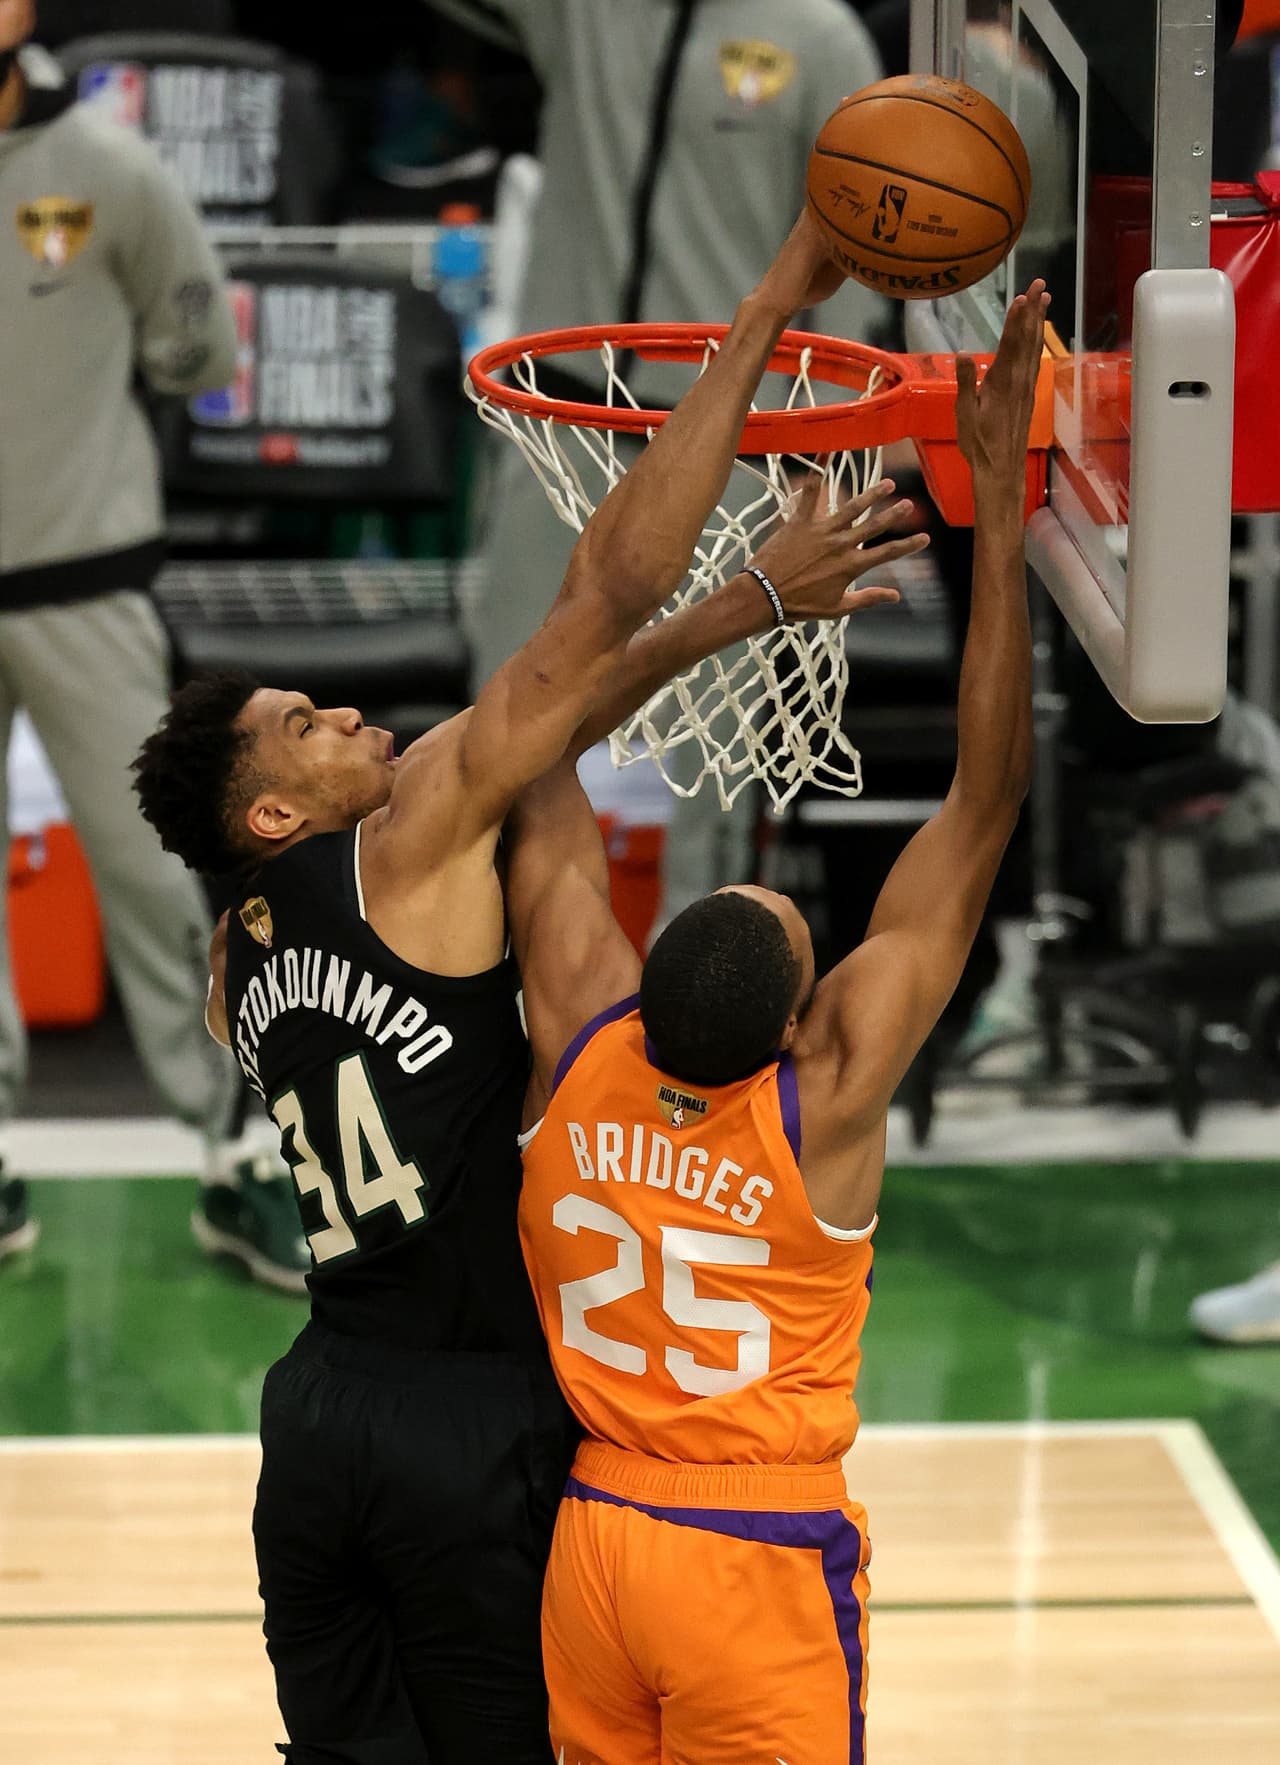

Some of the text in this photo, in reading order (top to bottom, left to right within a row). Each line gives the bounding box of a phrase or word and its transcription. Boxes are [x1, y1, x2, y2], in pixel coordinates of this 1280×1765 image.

[833, 246, 960, 291] SPALDIN
[237, 948, 453, 1101] TETOKOUNMPO
[272, 1055, 425, 1264] 34
[658, 1086, 708, 1114] NBA FINALS
[567, 1123, 774, 1227] BRIDGES
[553, 1192, 771, 1397] 25
